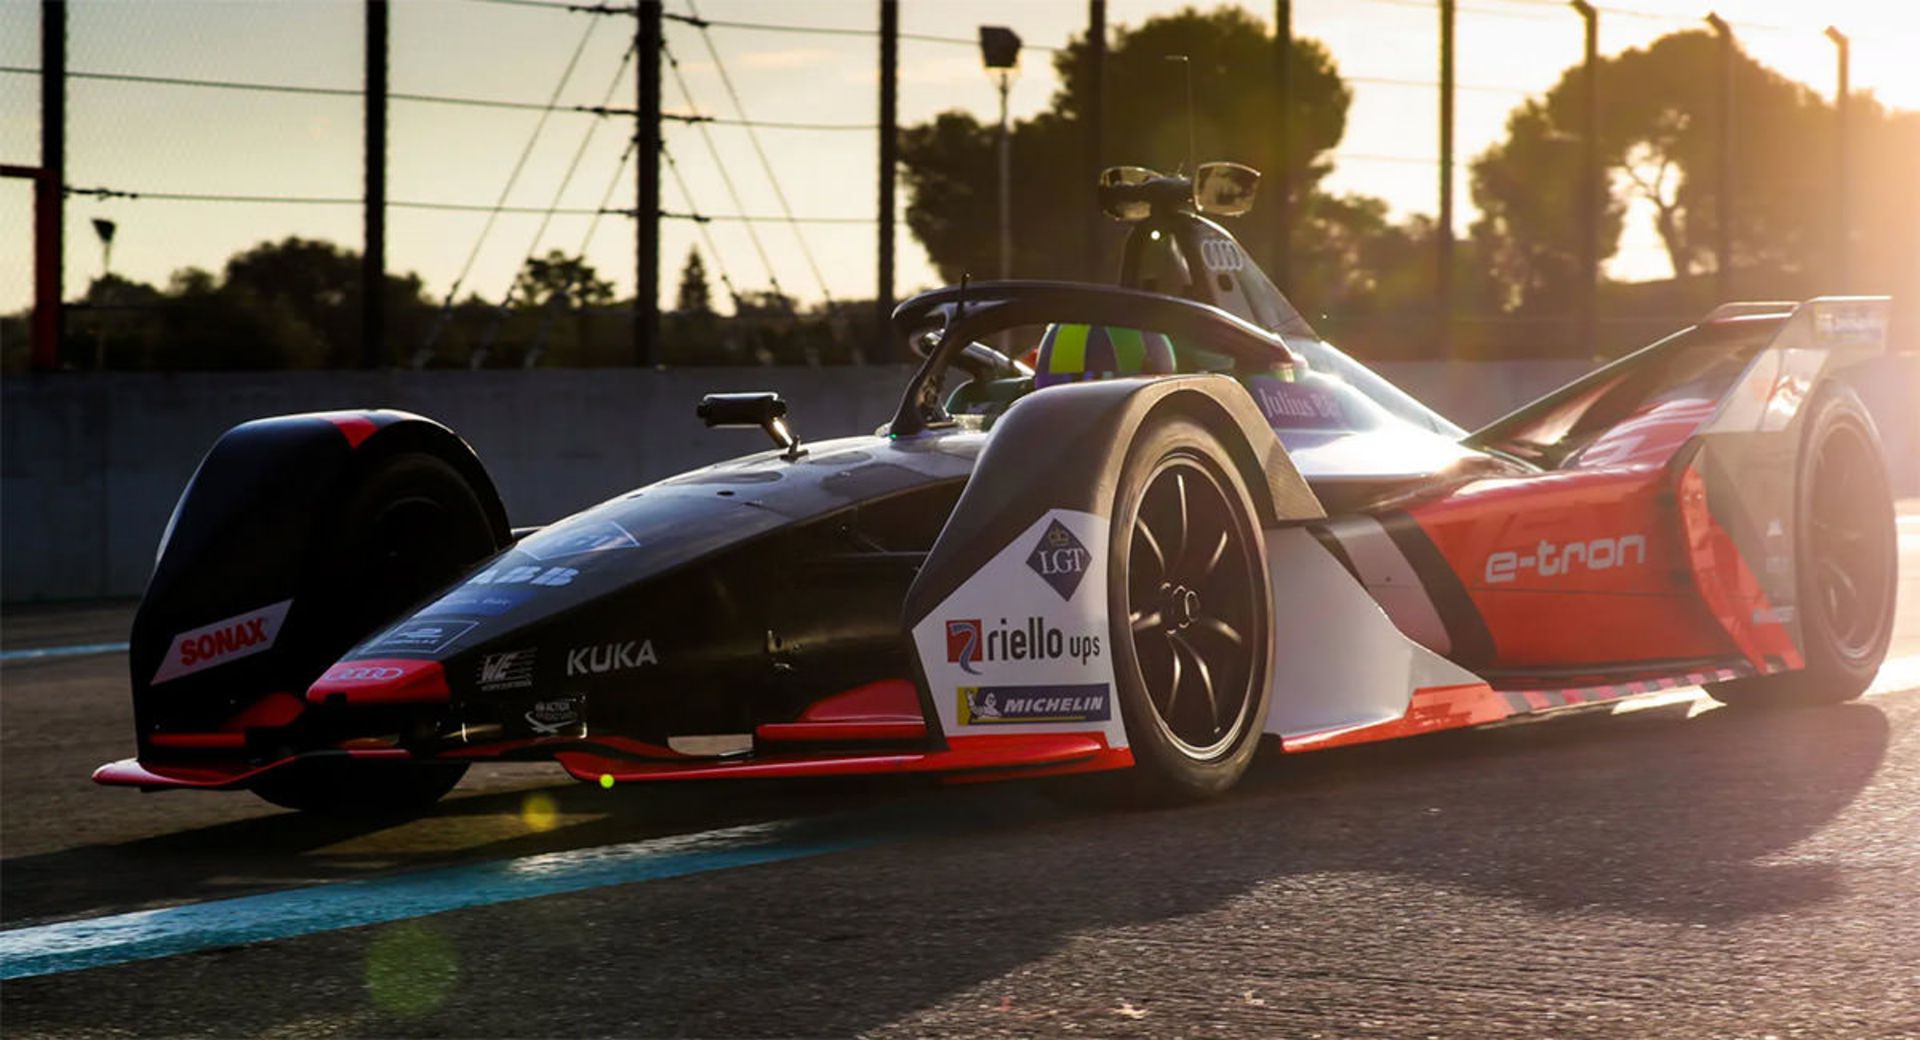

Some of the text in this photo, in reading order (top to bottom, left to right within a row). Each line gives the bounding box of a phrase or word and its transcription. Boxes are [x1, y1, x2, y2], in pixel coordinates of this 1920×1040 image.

[1039, 547, 1085, 575] LGT
[1485, 534, 1646, 583] e-tron
[180, 617, 268, 666] SONAX
[567, 639, 658, 676] KUKA
[987, 616, 1101, 665] riello ups
[1004, 695, 1103, 713] MICHELIN
